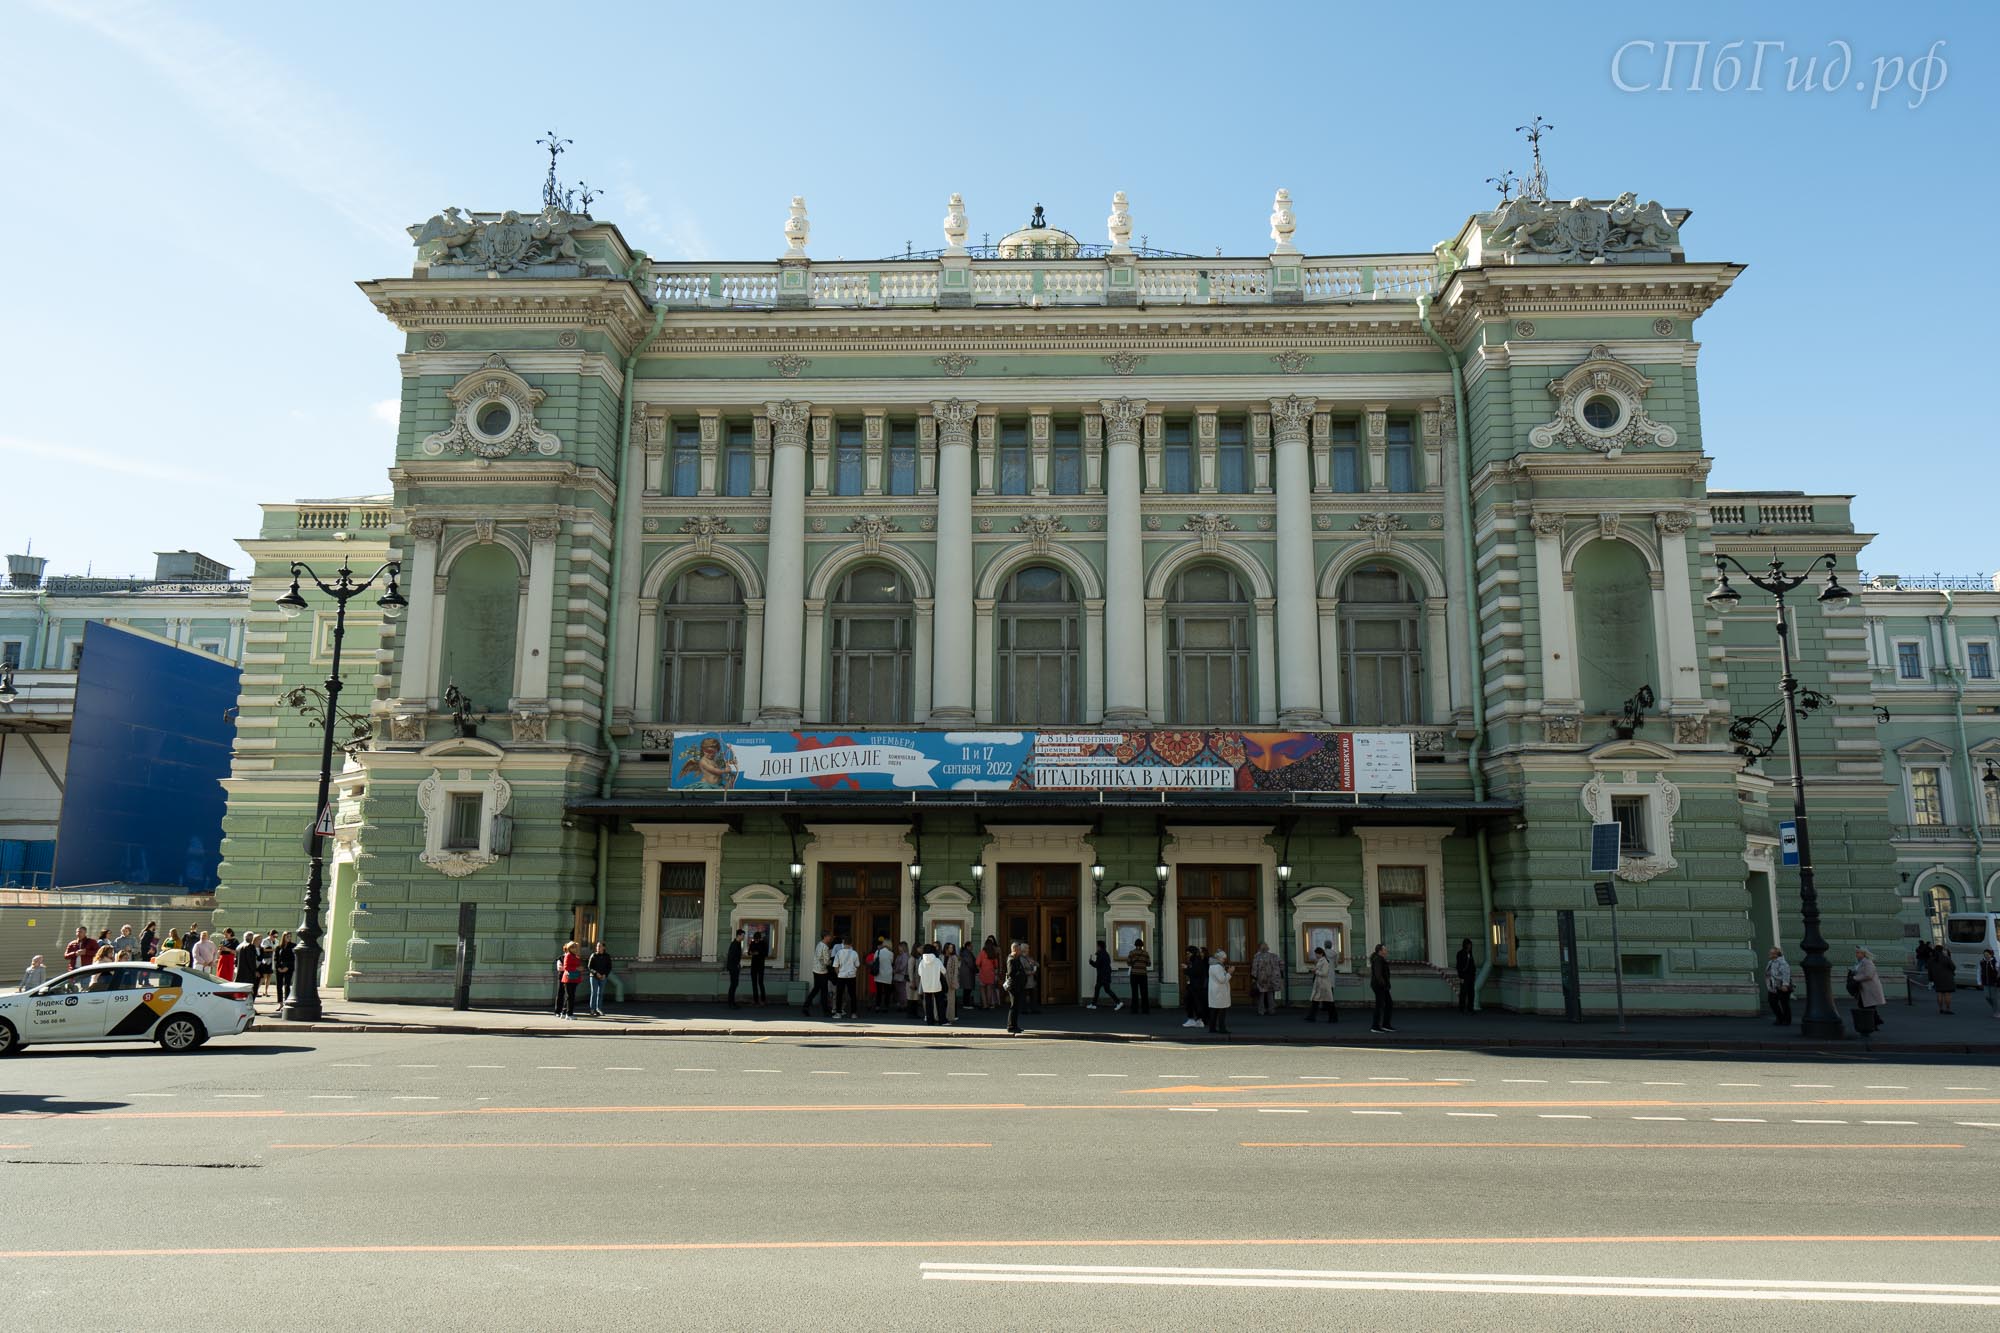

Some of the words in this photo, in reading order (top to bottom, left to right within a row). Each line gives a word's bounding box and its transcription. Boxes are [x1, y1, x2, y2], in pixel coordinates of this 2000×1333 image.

[870, 735, 915, 749] ПРЕМЬЕРА
[1047, 734, 1054, 743] 8
[1065, 734, 1074, 743] 15
[962, 746, 970, 761] 11
[983, 746, 994, 761] 17
[1036, 745, 1077, 753] Премьера
[760, 758, 792, 777] ДОН
[799, 749, 882, 773] ПАСКУАЛЕ
[942, 764, 981, 775] СЕНТЯБРЯ
[986, 761, 1013, 776] 2022
[1342, 738, 1351, 788] MARIINSKY.RU
[1036, 769, 1138, 786] ИТАЛЬЯНКА
[1143, 769, 1153, 786] В
[1158, 769, 1231, 786] АЛЖИРЕ
[66, 997, 77, 1005] Go
[114, 995, 129, 1003] 993
